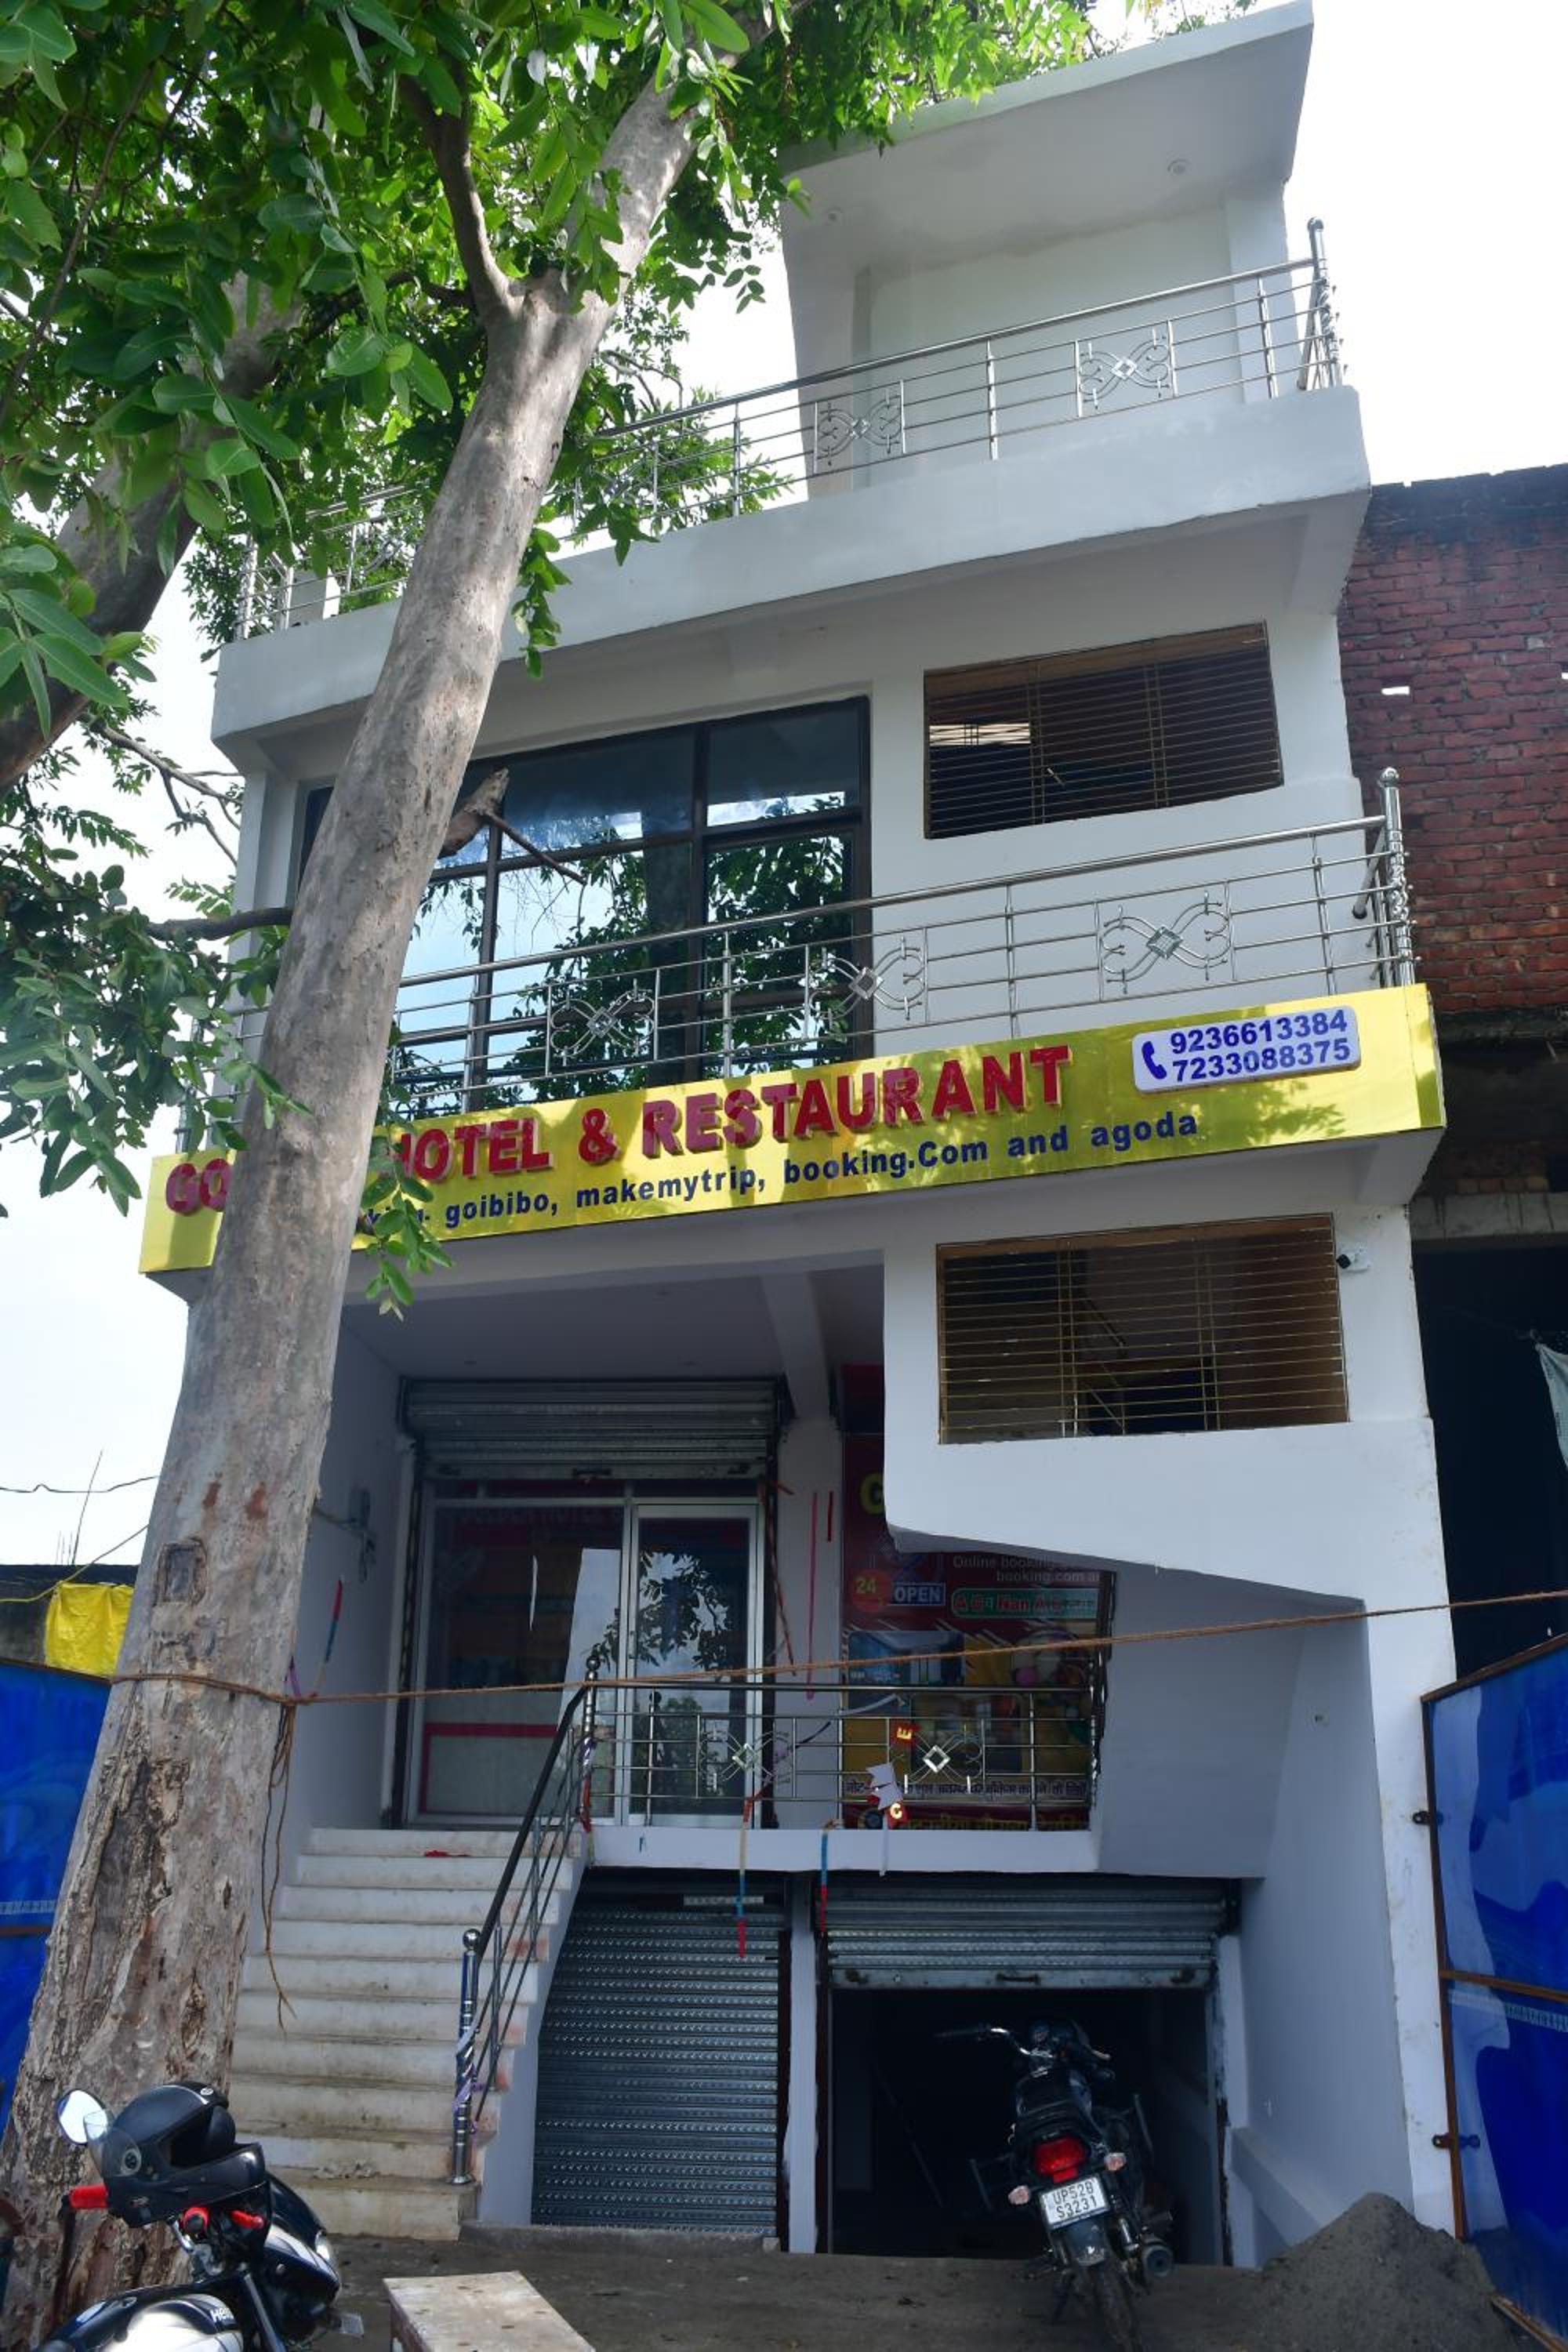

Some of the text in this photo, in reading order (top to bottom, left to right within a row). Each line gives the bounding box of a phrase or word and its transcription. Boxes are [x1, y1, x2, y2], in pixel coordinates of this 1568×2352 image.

[1169, 1008, 1348, 1054] 9236613384
[1171, 1036, 1352, 1082] 7233088375
[577, 1107, 621, 1164] &
[642, 1044, 1073, 1159] RESTAURANT
[445, 1190, 558, 1229] goibibo,
[576, 1165, 766, 1208] makemytrip,
[783, 1139, 989, 1185] booking.Com
[1007, 1123, 1069, 1157] and
[1091, 1111, 1198, 1152] agoda
[895, 1586, 942, 1602] OPEN
[1057, 2195, 1097, 2219] S3231
